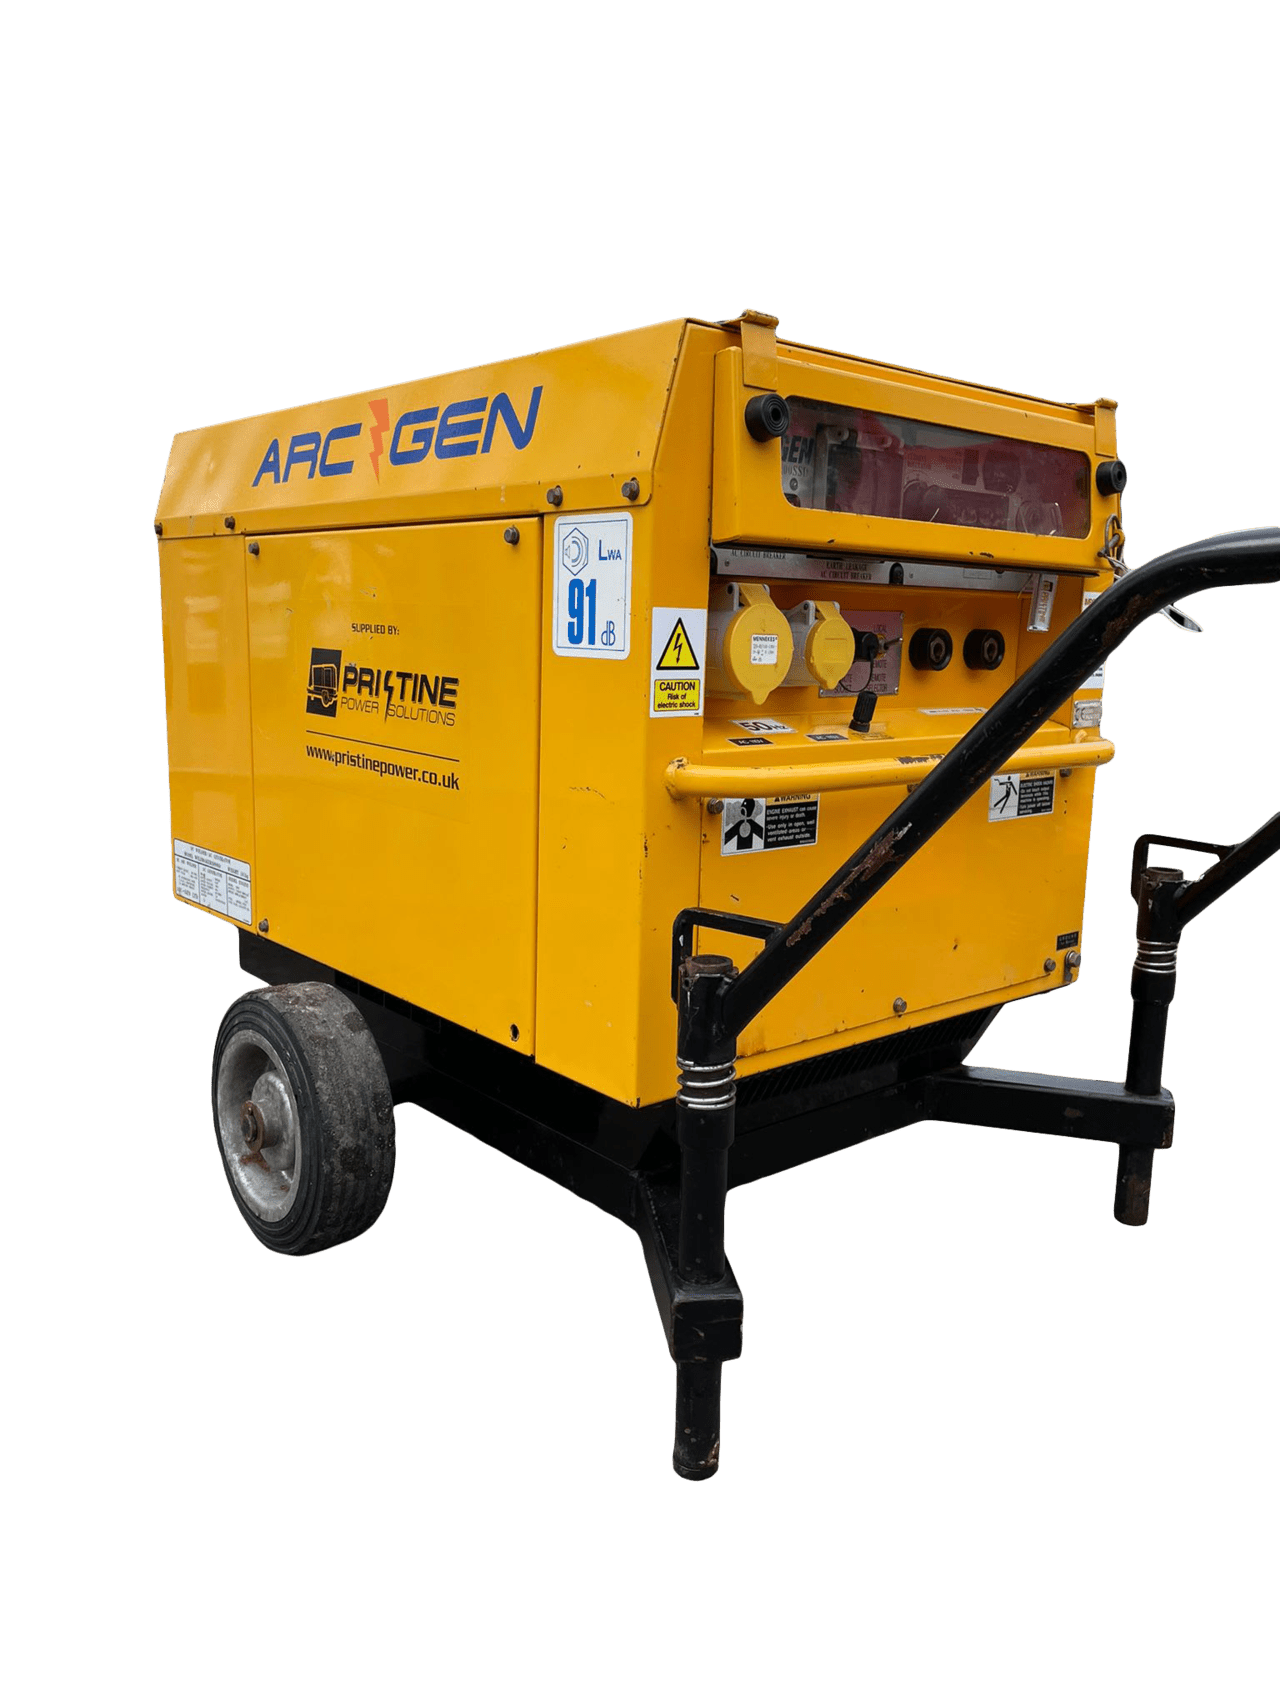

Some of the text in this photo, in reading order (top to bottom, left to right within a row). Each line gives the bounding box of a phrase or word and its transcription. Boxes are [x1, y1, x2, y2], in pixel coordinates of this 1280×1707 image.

[252, 386, 543, 487] ARC GEN
[568, 579, 596, 645] 91
[351, 623, 400, 635] SUPPLIED BY:
[601, 620, 616, 646] dB
[342, 665, 460, 709] PRISTINE
[659, 682, 695, 691] CAUTION
[341, 696, 455, 727] POWER SOLUTIONS
[657, 701, 678, 709] electric
[306, 745, 459, 790] www.pristinepower.co.uk
[782, 806, 798, 814] EXHAUST
